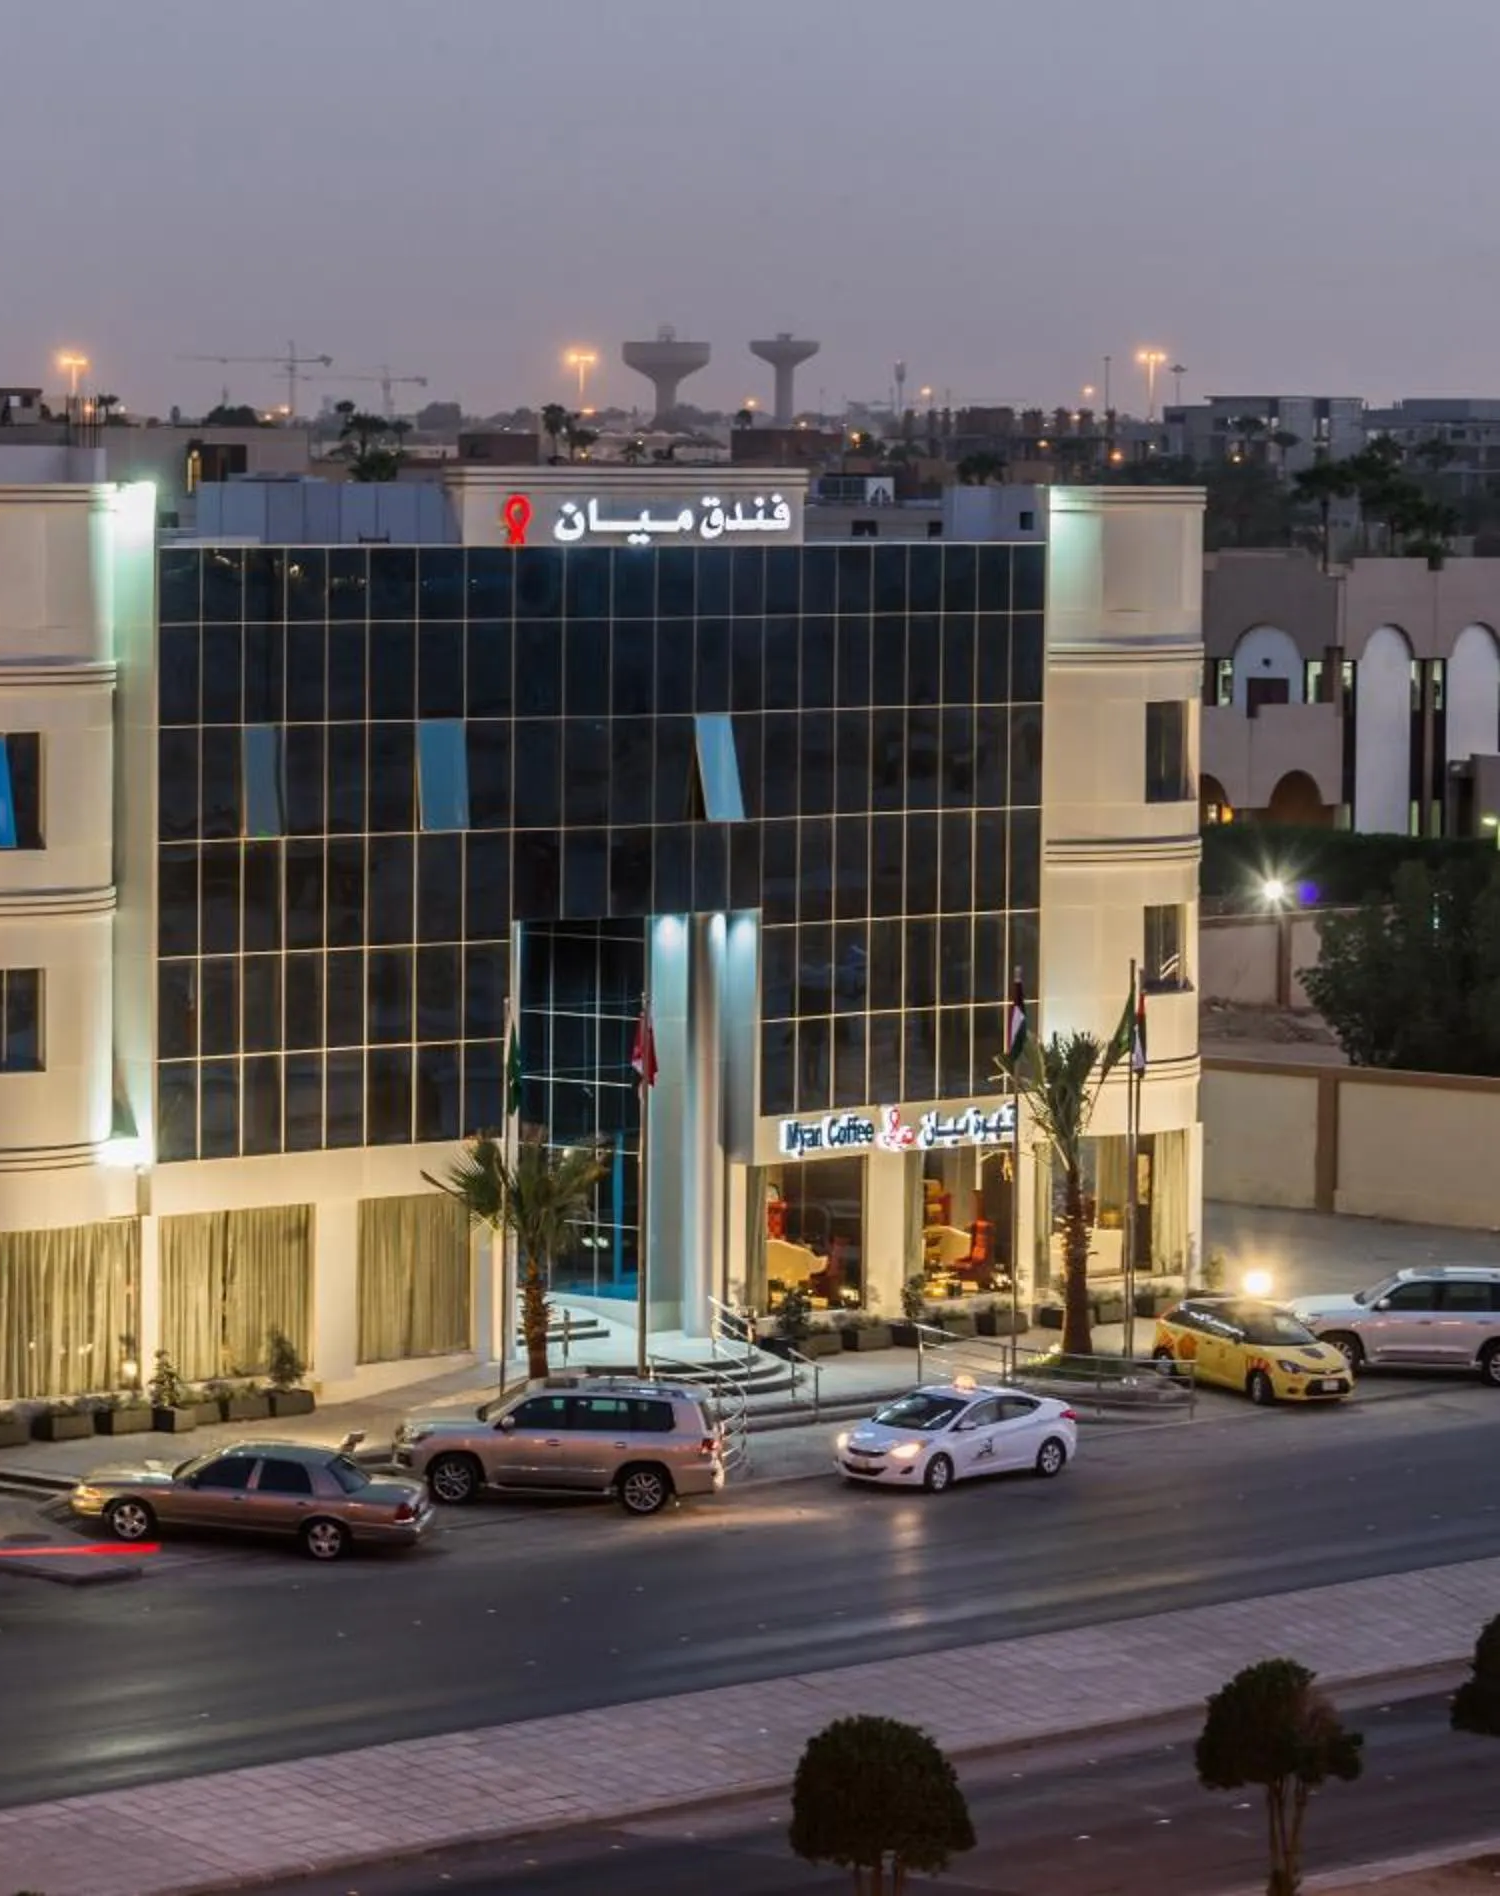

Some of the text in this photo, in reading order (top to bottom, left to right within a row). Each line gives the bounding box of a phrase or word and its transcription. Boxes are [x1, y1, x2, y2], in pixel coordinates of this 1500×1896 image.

[553, 494, 791, 544] فندق ميان
[782, 1120, 823, 1157] Myan
[825, 1115, 874, 1147] Coffee
